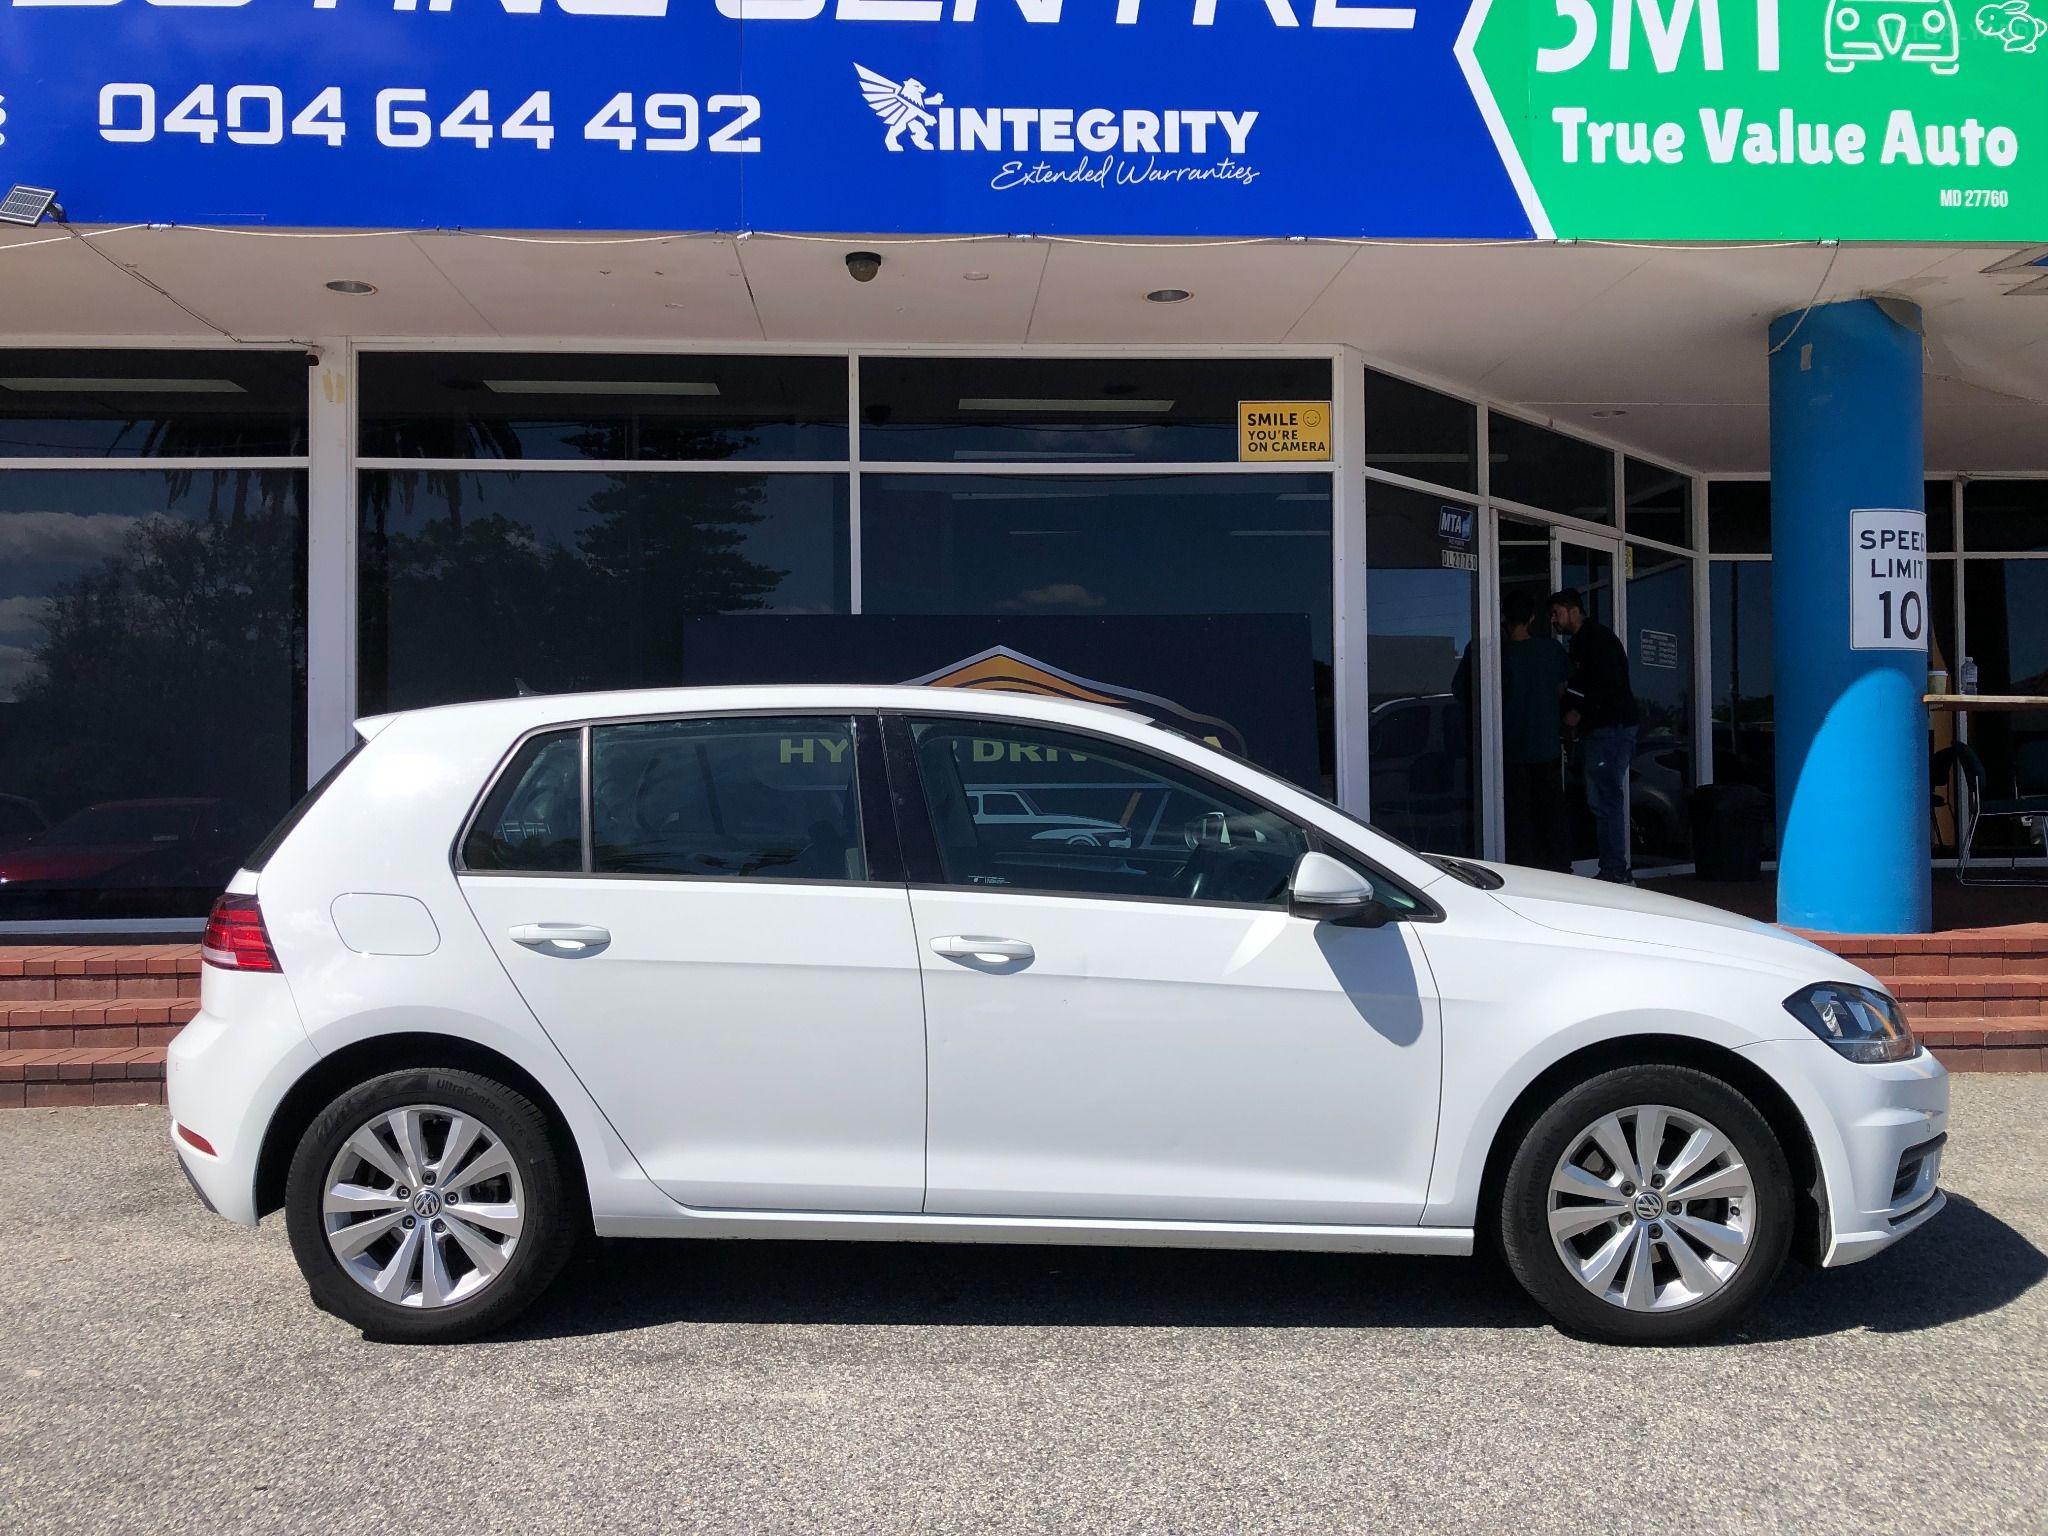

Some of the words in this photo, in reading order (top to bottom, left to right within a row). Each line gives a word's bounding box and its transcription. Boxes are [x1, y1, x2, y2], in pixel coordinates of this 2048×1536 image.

[99, 83, 346, 146] 0404
[376, 88, 555, 149] 644
[584, 92, 761, 153] 492
[939, 108, 1260, 155] INTEGRITY
[1551, 107, 1686, 164] True
[1698, 108, 1866, 165] Value
[1880, 110, 2018, 167] Auto
[990, 154, 1113, 190] Extended
[1115, 155, 1261, 185] Warranties
[1940, 189, 1962, 207] MD
[1965, 189, 2009, 208] 27760
[1247, 412, 1299, 427] SMILE
[1247, 429, 1299, 441] YOU'RE
[1248, 441, 1268, 453] ON
[1271, 441, 1326, 452] CAMERA
[1441, 512, 1462, 534] MTA
[1870, 557, 1924, 580] LIMIT
[1878, 589, 1923, 641] 10
